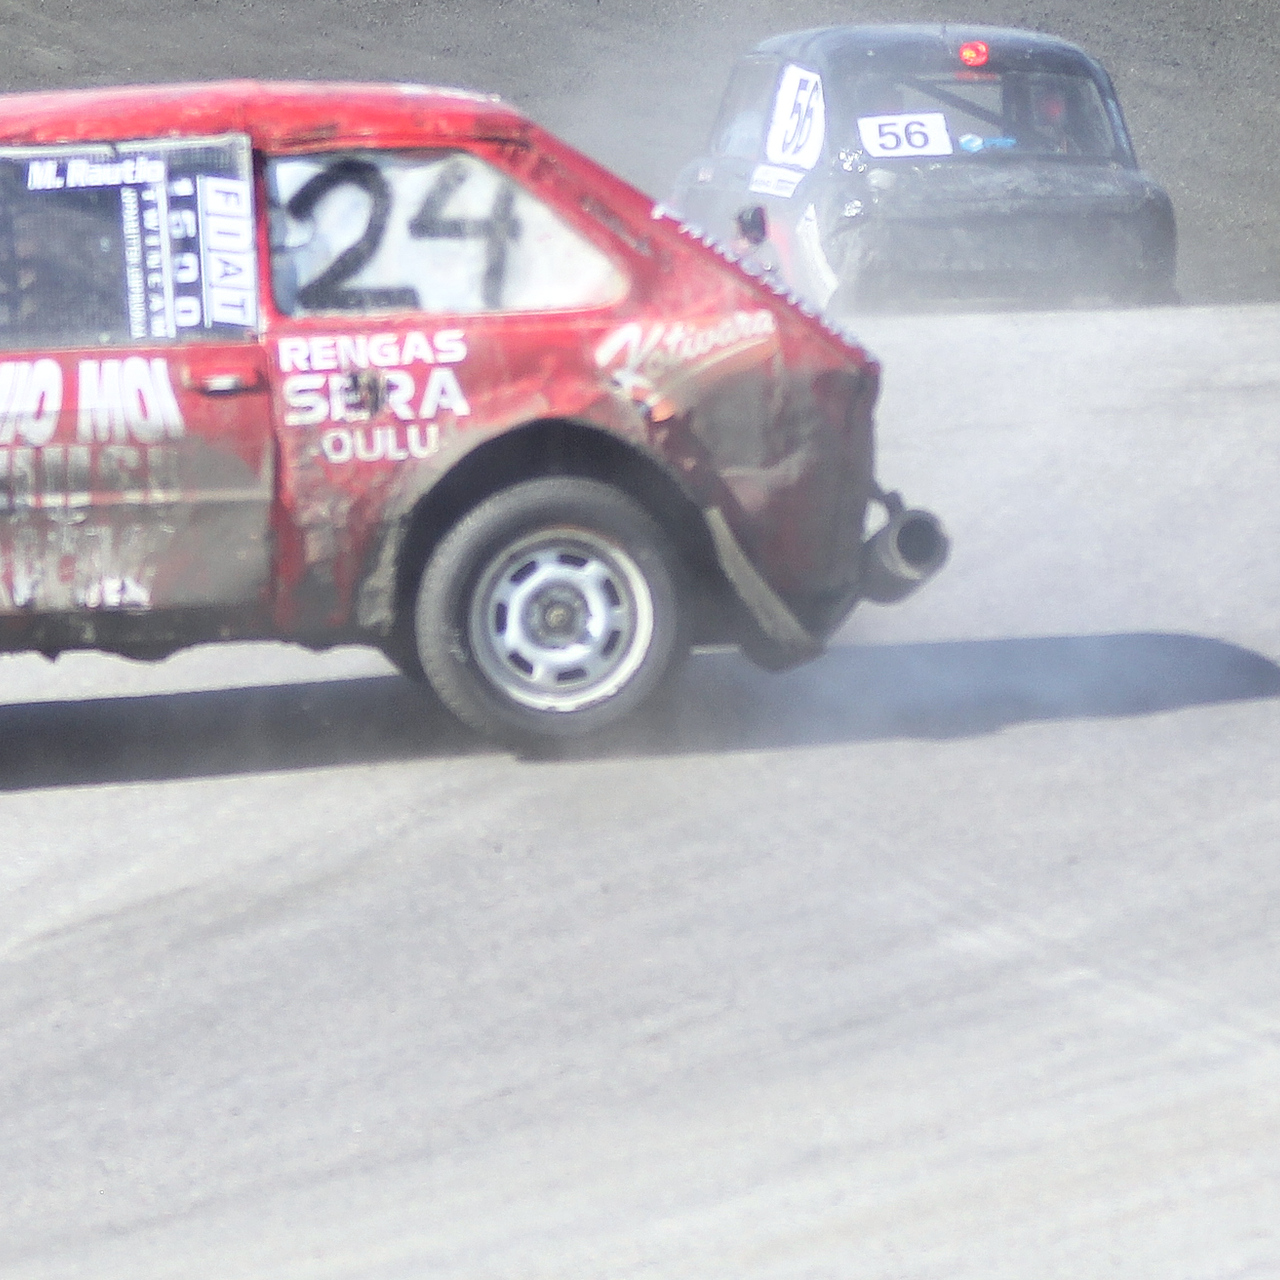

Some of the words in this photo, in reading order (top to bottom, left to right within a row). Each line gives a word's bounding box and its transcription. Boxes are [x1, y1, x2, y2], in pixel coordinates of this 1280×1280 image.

[876, 122, 930, 151] 56
[27, 160, 65, 190] M.
[207, 182, 252, 320] FIAT
[288, 158, 524, 310] 24
[277, 332, 468, 371] RENGAS
[322, 425, 440, 463] OULU
